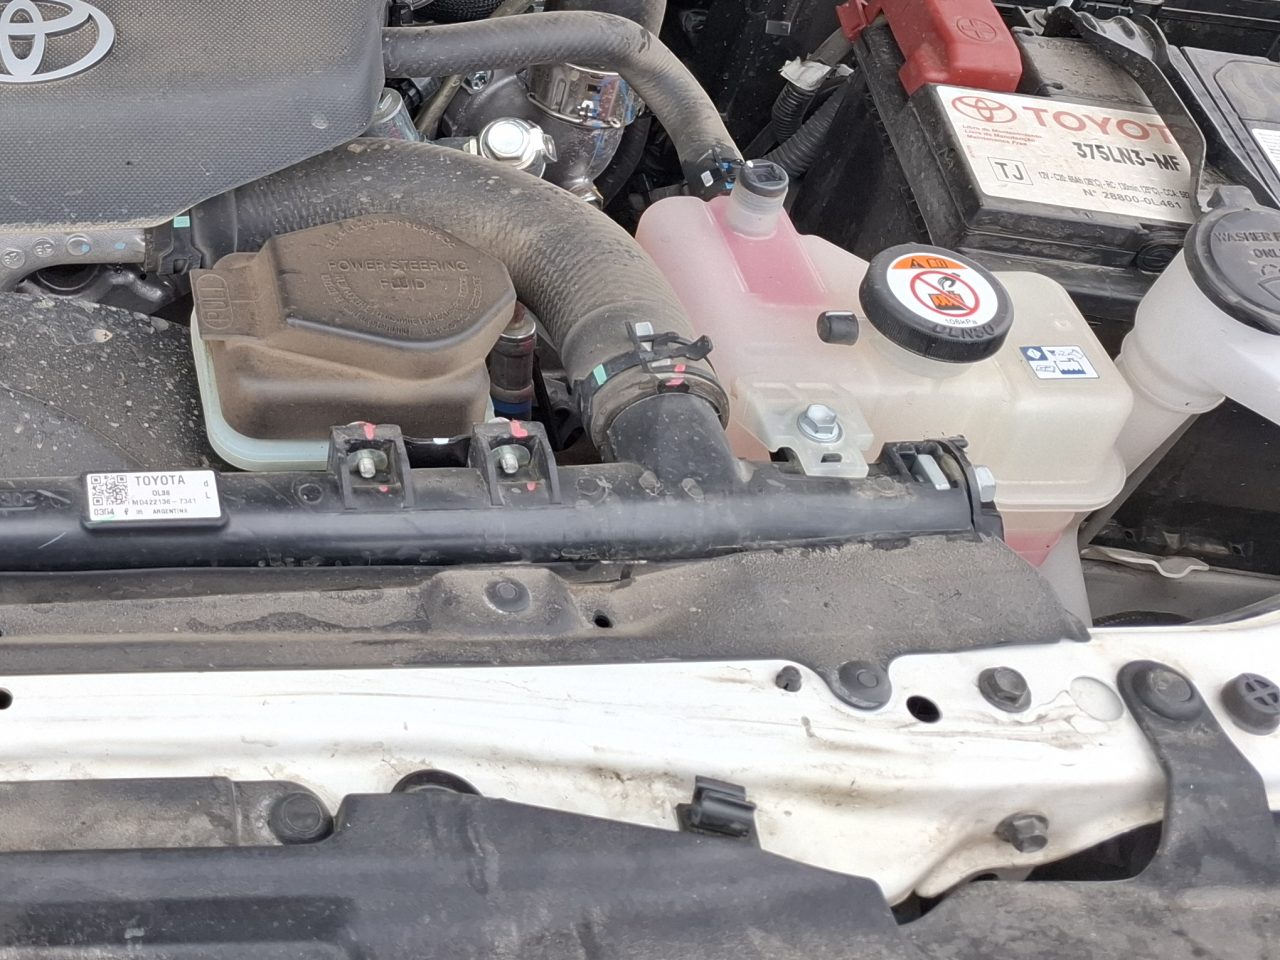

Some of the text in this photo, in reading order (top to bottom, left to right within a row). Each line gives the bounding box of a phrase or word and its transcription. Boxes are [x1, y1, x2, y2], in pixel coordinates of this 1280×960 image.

[1022, 106, 1173, 145] TOYOT
[1072, 141, 1181, 172] 375LN3-MF
[994, 161, 1024, 181] TJ
[1214, 231, 1272, 242] WASHER
[1253, 248, 1280, 259] ONL
[328, 260, 469, 272] POWER STEERING
[378, 278, 427, 291] FLUID
[134, 474, 186, 487] TOYOTA
